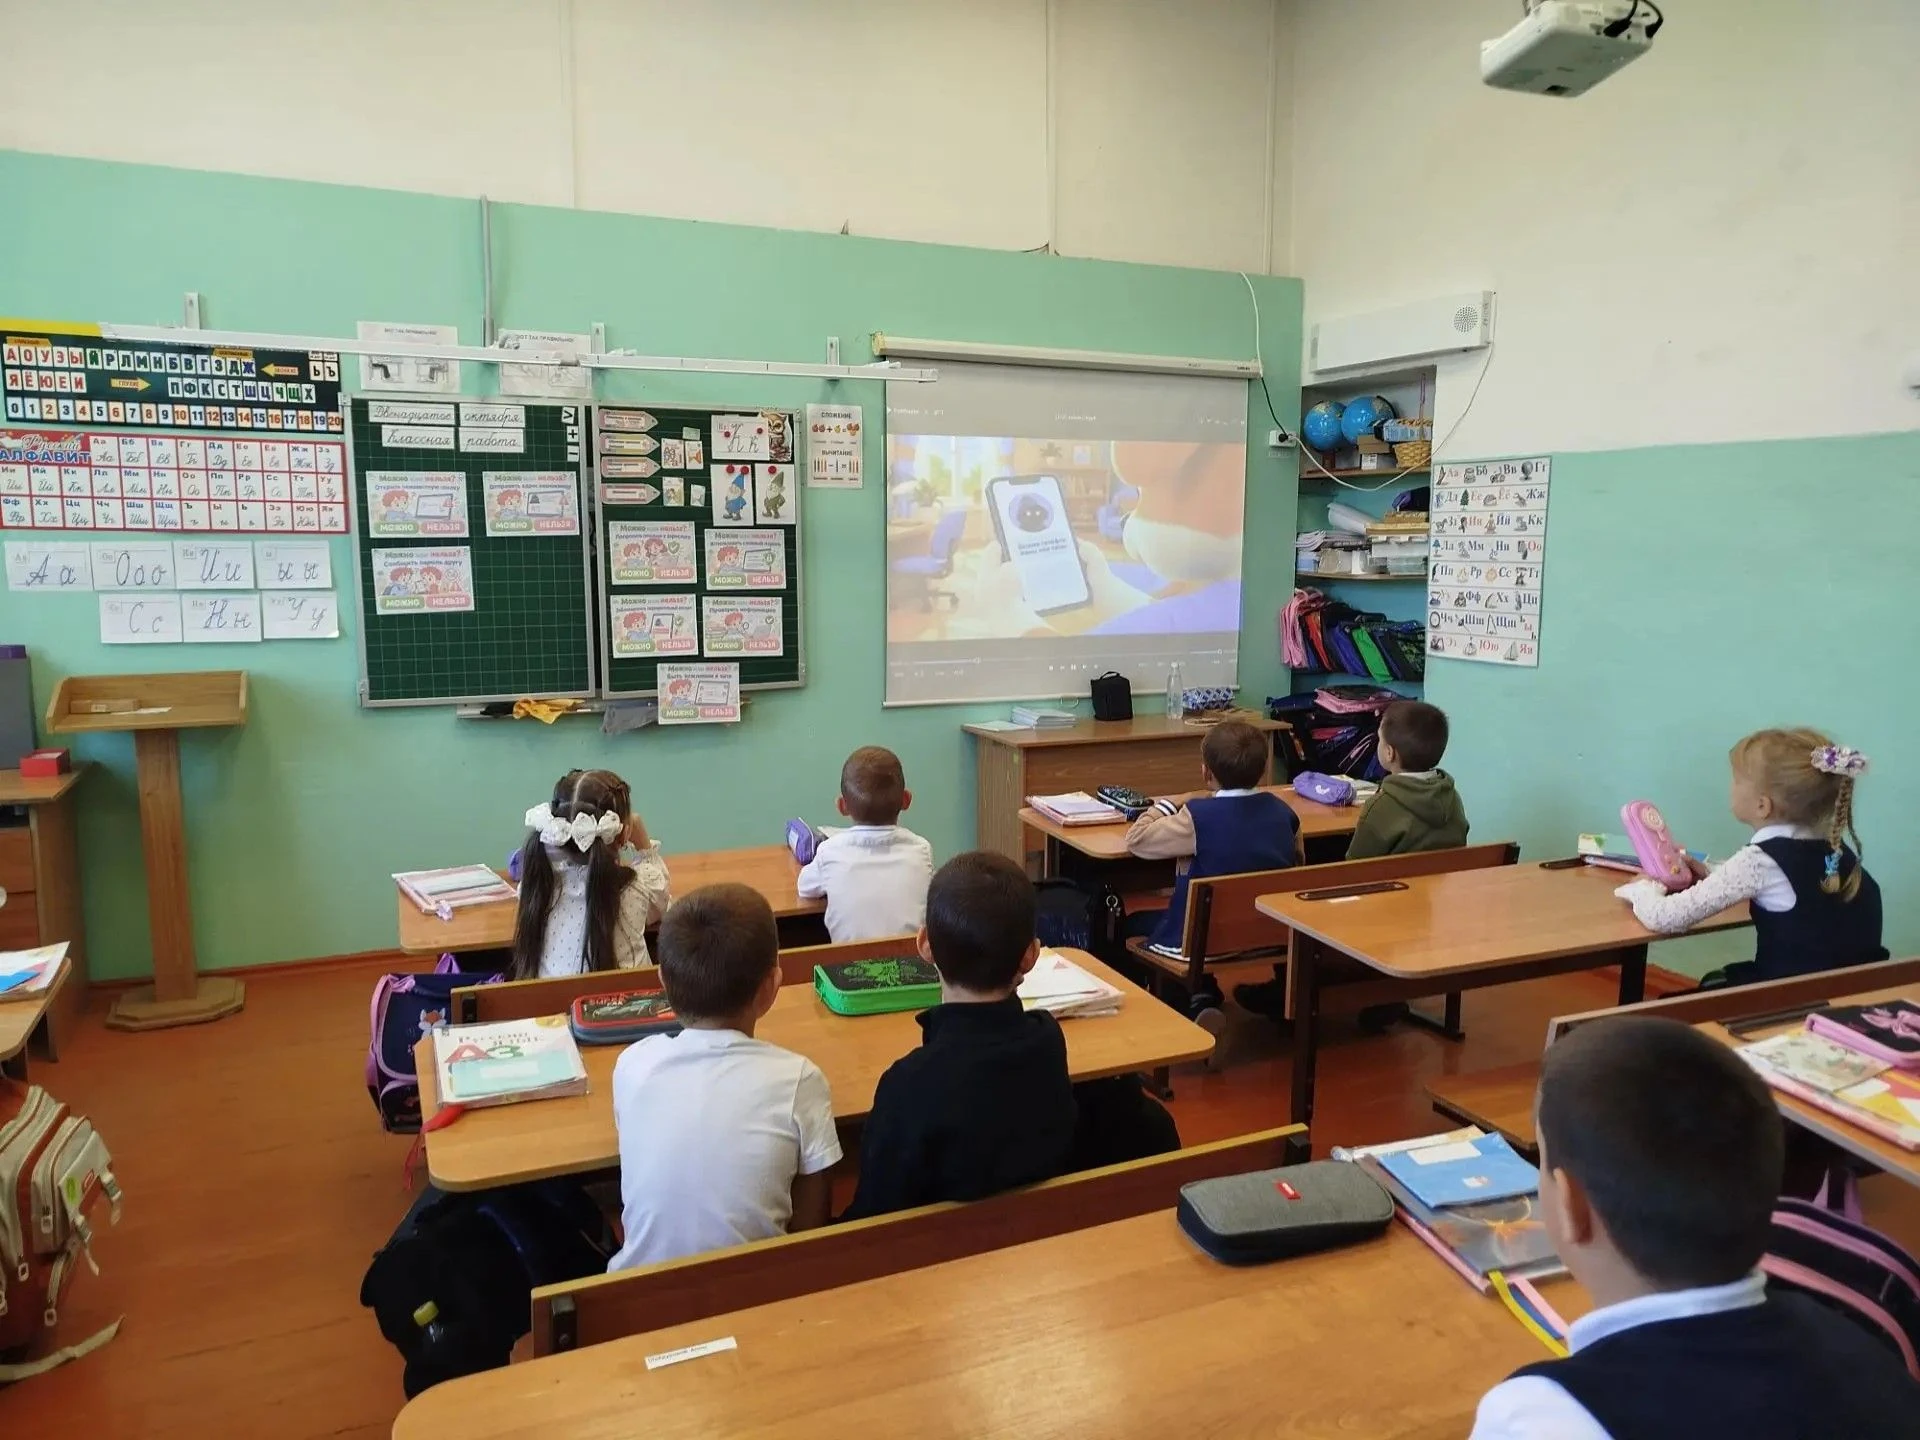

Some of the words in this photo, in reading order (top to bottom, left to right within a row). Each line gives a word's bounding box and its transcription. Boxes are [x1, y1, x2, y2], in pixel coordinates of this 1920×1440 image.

[7, 348, 16, 361] А
[24, 349, 32, 361] О
[41, 350, 49, 362] У
[70, 351, 83, 364] Ы
[89, 350, 99, 365] Й
[105, 354, 115, 366] Р
[121, 354, 131, 367] Л
[136, 355, 148, 368] М
[153, 356, 162, 369] Н
[169, 357, 178, 370] Б
[184, 358, 193, 370] В
[200, 359, 208, 371] Г
[214, 359, 223, 372] З
[229, 361, 240, 375] Д
[242, 362, 255, 374] Ж
[313, 365, 320, 376] Ь
[326, 366, 336, 377] Ъ
[9, 374, 18, 386] Я
[25, 372, 33, 387] Ё
[39, 376, 53, 388] Ю
[59, 376, 67, 388] Е
[74, 377, 84, 389] И
[171, 382, 180, 395] П
[184, 382, 196, 395] Ф
[201, 383, 211, 396] К
[218, 384, 225, 396] С
[232, 385, 240, 397] Т
[244, 385, 256, 397] Ш
[261, 386, 270, 400] Ц
[276, 387, 283, 398] Ч
[288, 388, 300, 401] Щ
[305, 388, 313, 400] Х
[29, 404, 35, 414] 1
[45, 404, 53, 414] 2
[62, 405, 70, 415] 3
[79, 406, 86, 416] 4
[96, 406, 103, 416] 5
[112, 408, 120, 418] 6
[129, 408, 136, 418] 7
[146, 409, 152, 419] 8
[161, 410, 168, 419] 9
[175, 410, 186, 420] 10
[192, 411, 203, 421] 11
[208, 412, 219, 421] 12
[223, 412, 235, 422] 13
[239, 413, 250, 422] 14
[254, 413, 265, 423] 15
[269, 414, 280, 424] 16
[285, 415, 295, 424] 17
[300, 415, 310, 424] 18
[314, 416, 325, 425] 19
[329, 416, 340, 426] 20
[387, 429, 450, 445] Классная
[464, 432, 517, 452] работа
[0, 450, 90, 463] АЛФАВИТ
[380, 524, 414, 532] МОЖНО
[427, 523, 460, 531] НЕЛЬЗЯ
[620, 569, 649, 577] МОЖНО
[661, 569, 689, 577] НЕЛЬЗЯ
[714, 576, 742, 584] МОЖНО
[385, 599, 420, 607] МОЖНО
[432, 597, 466, 605] НЕЛЬЗЯ
[705, 708, 733, 716] НЕЛЬЗЯ
